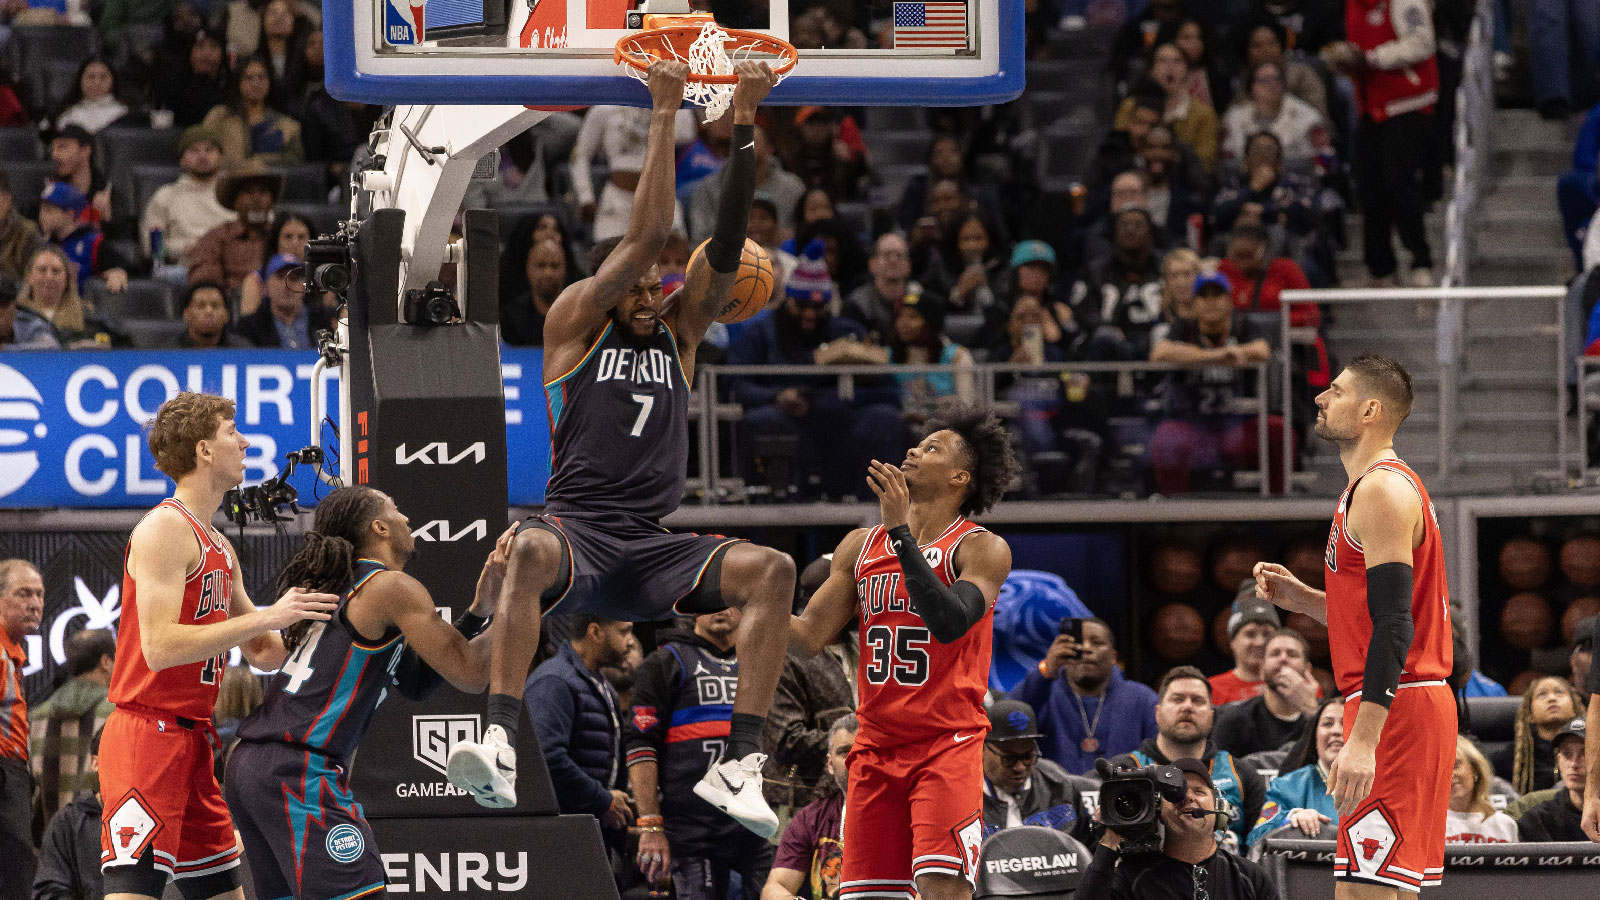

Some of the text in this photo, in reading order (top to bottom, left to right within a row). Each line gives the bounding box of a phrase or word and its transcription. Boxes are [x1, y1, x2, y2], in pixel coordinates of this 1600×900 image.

[390, 25, 409, 41] NBA
[630, 393, 654, 436] 7
[64, 434, 279, 494] CLB
[866, 625, 931, 686] 35
[334, 835, 355, 846] DETROIT
[335, 841, 357, 851] PISTONS
[380, 851, 528, 893] ENRY
[986, 853, 1077, 874] FIEGERLAW
